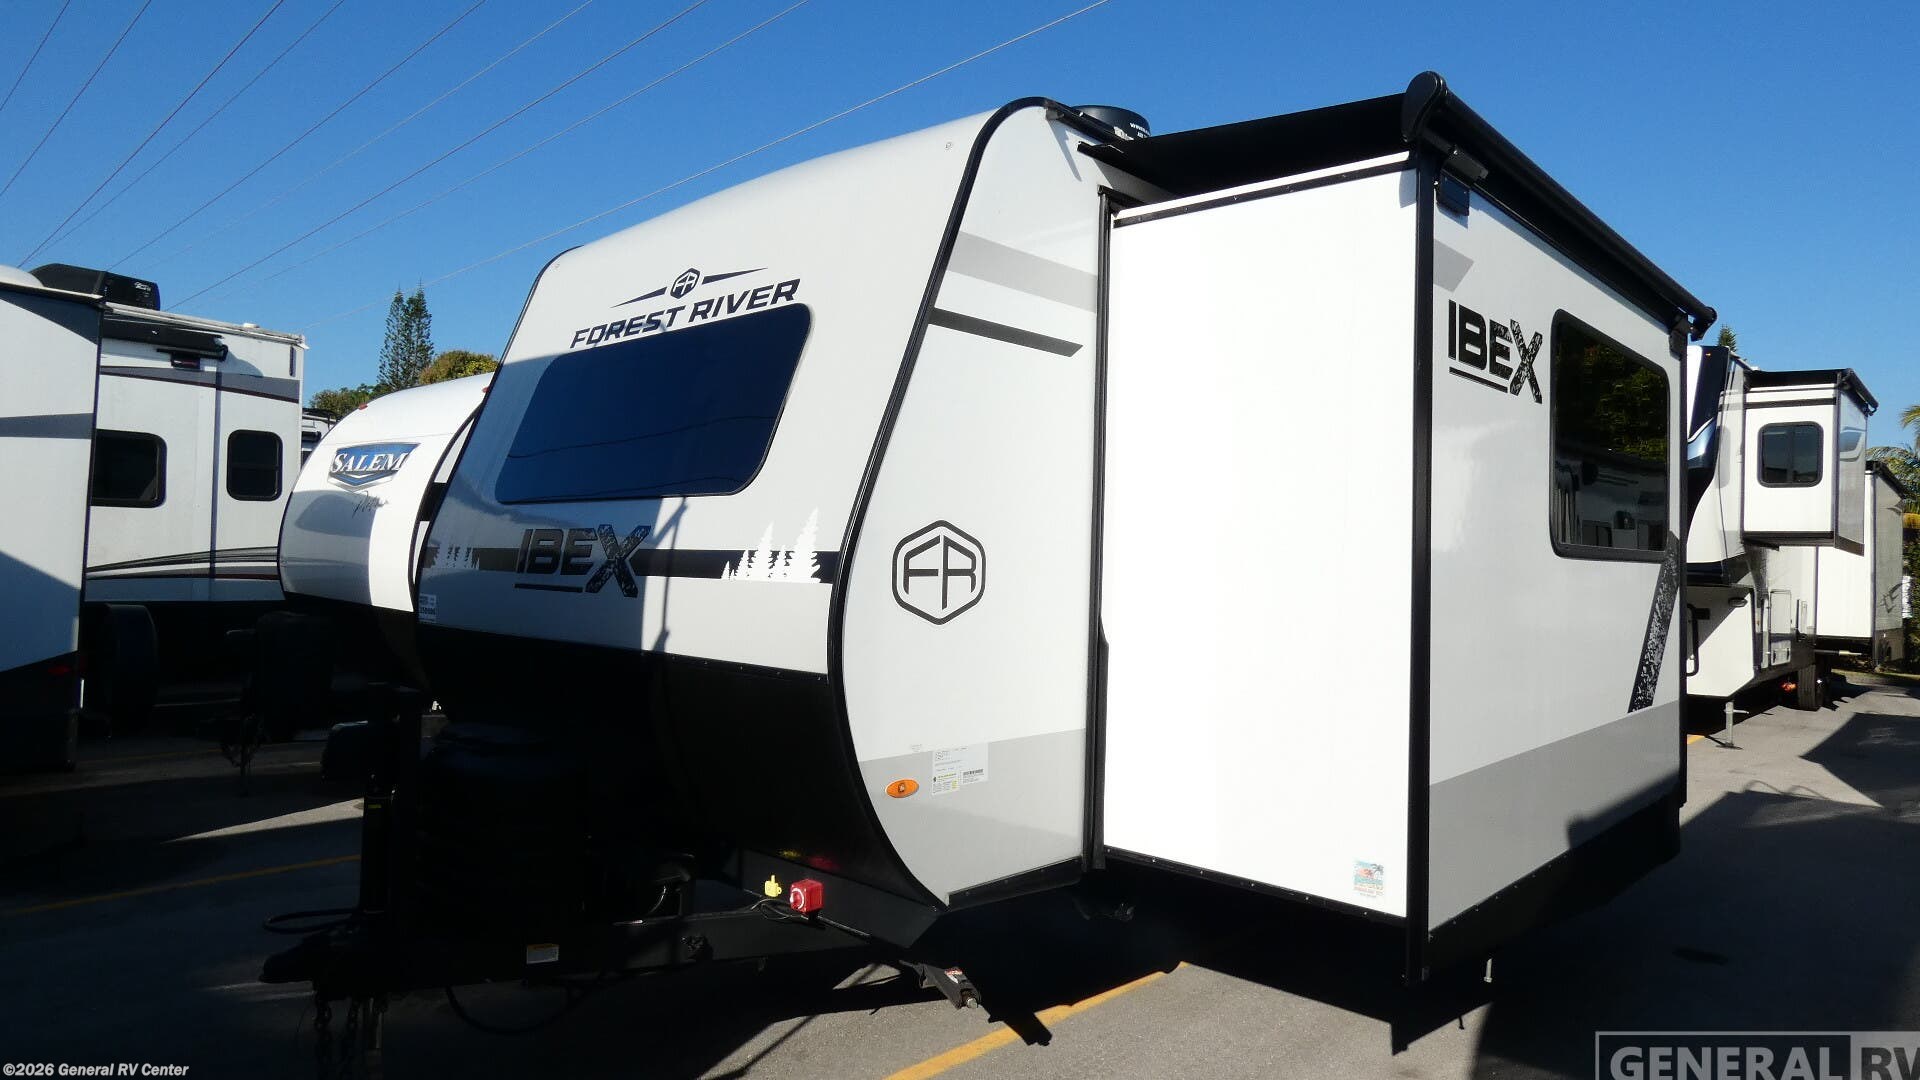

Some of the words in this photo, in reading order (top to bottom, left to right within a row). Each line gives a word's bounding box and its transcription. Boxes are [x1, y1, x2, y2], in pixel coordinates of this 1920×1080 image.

[570, 305, 685, 349] FOREST
[688, 278, 801, 323] RIVER
[1448, 299, 1543, 404] IBEX
[330, 452, 409, 474] SALEM
[516, 523, 652, 598] IBEX
